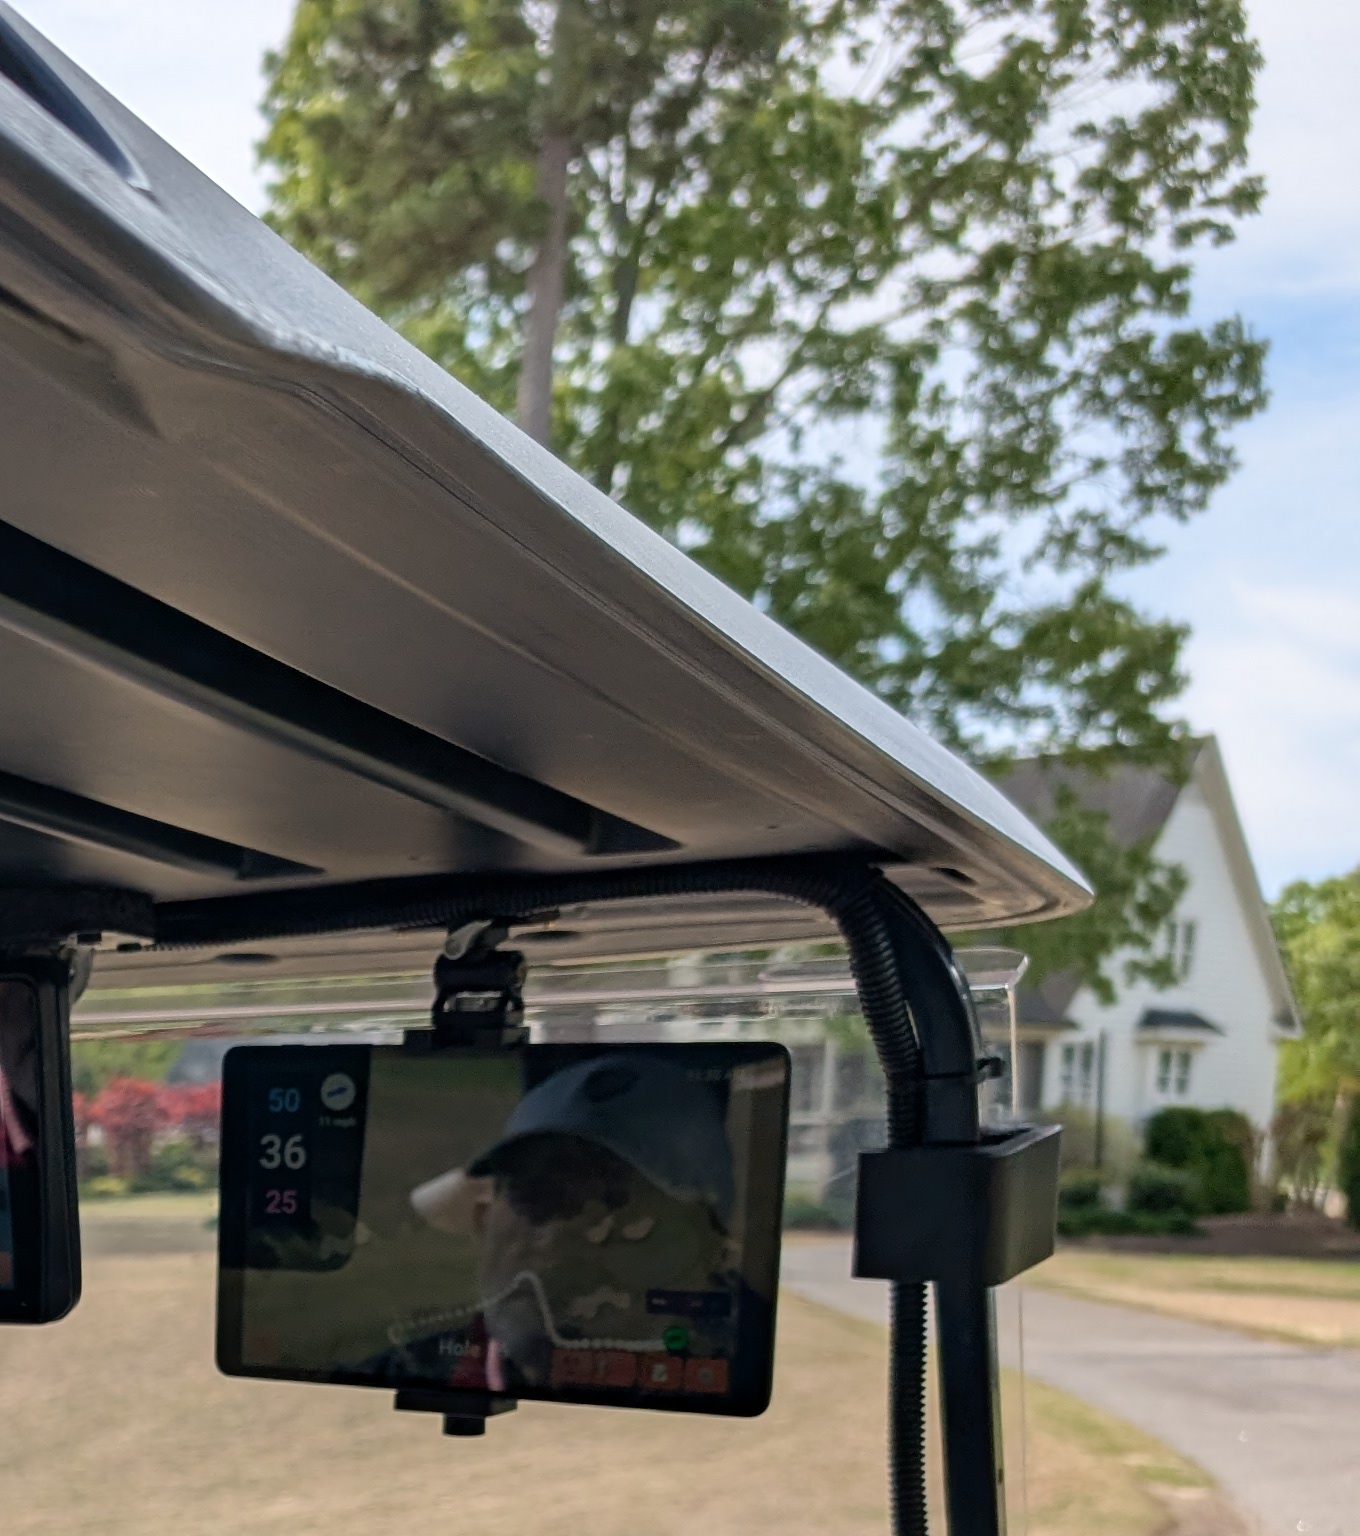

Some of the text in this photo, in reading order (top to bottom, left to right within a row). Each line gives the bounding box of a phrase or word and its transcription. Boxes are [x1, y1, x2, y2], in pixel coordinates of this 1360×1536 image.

[268, 1087, 302, 1113] 50
[259, 1132, 307, 1170] 36
[265, 1189, 298, 1214] 25
